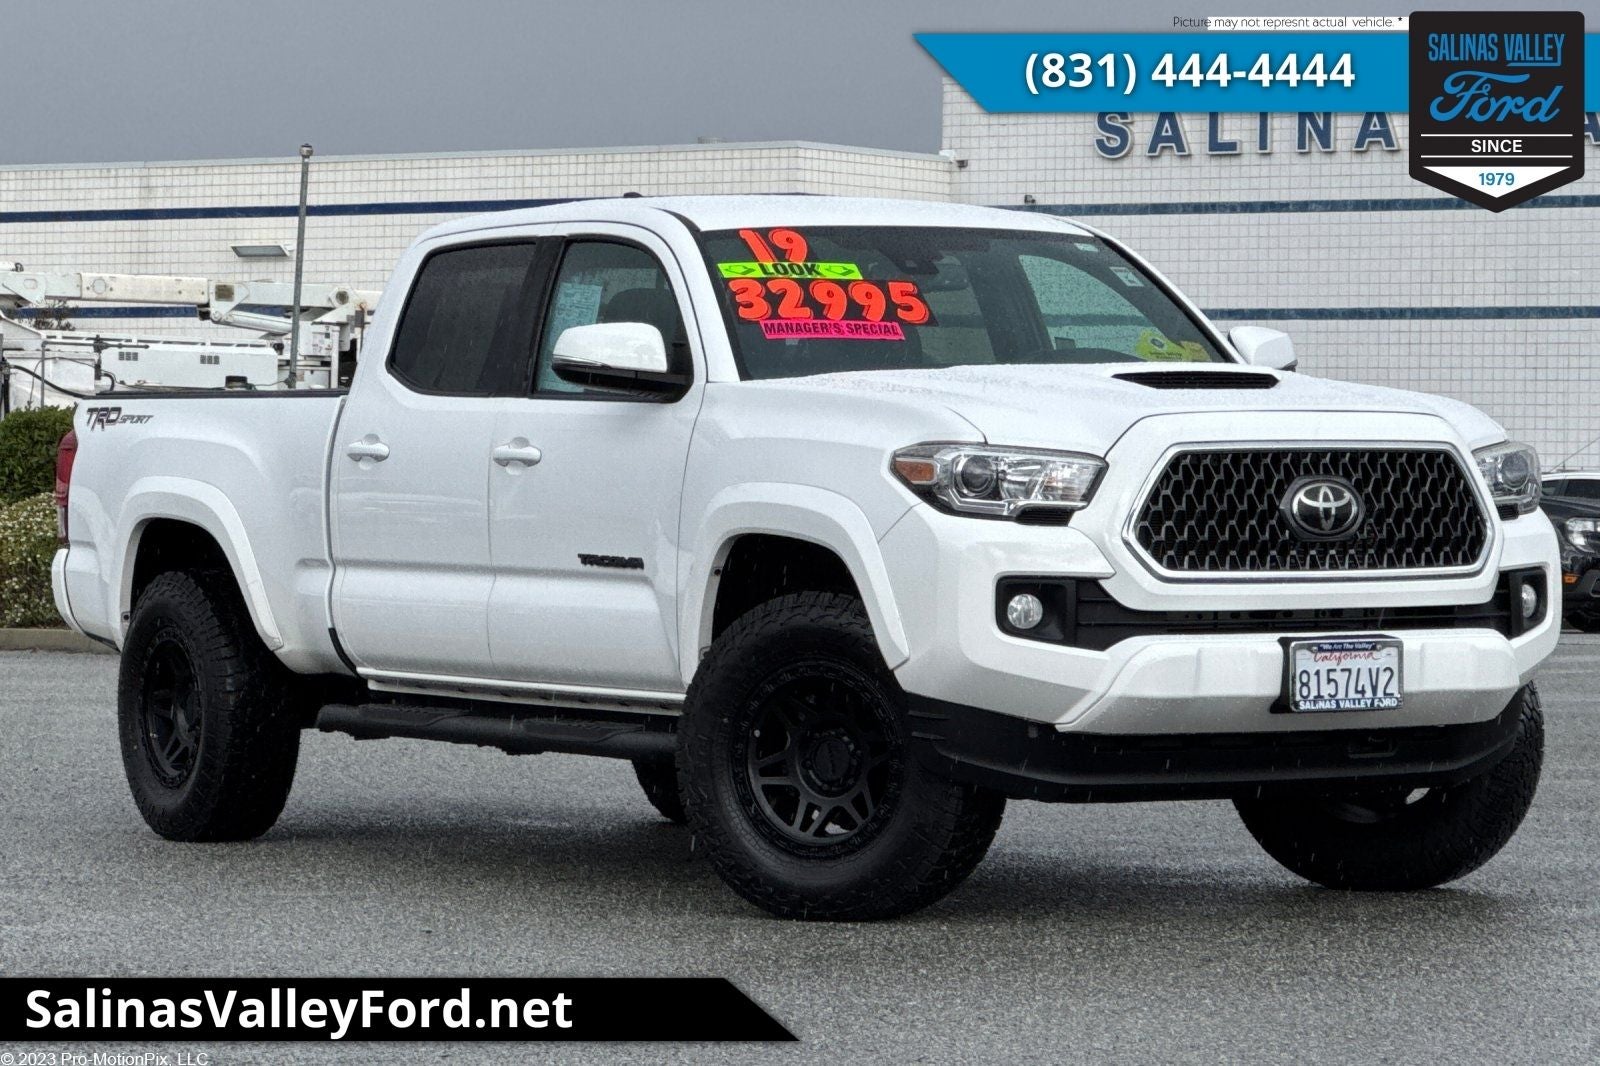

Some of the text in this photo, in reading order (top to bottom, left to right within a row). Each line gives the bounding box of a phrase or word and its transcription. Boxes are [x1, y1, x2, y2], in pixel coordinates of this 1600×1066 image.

[738, 227, 809, 263] 19
[758, 262, 822, 277] LOOK
[728, 278, 930, 324] 32995
[764, 322, 900, 336] MANAGER'S SPECIAL
[86, 406, 154, 432] TRD SPORT
[1314, 650, 1381, 666] California
[1298, 667, 1395, 699] 81574V2
[1299, 698, 1398, 710] SALINAS VALLEY FORD
